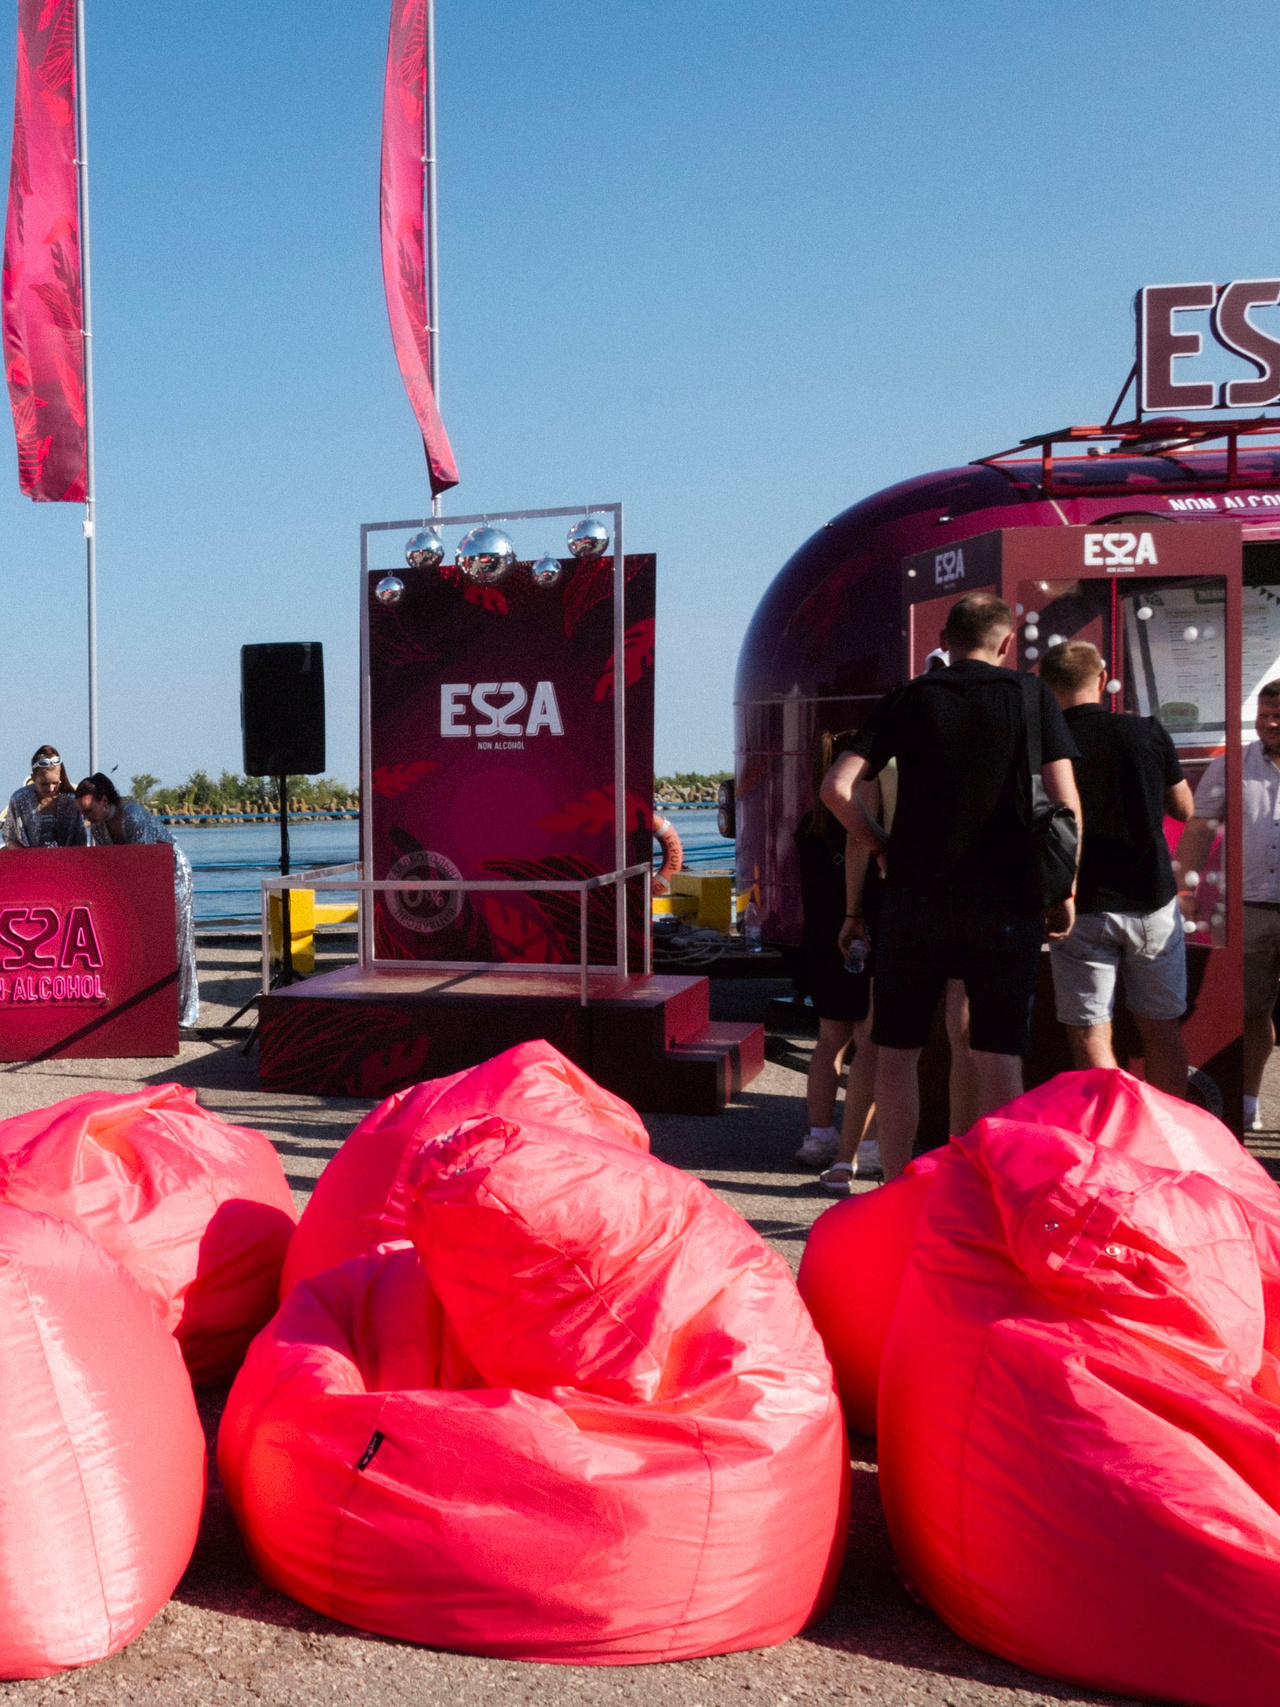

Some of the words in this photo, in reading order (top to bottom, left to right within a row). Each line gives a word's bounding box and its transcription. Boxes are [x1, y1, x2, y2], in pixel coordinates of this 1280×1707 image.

[1142, 278, 1280, 411] ES
[477, 742, 492, 750] NON
[494, 741, 525, 750] ALCOHOL
[13, 974, 107, 1001] ALCOHOL
